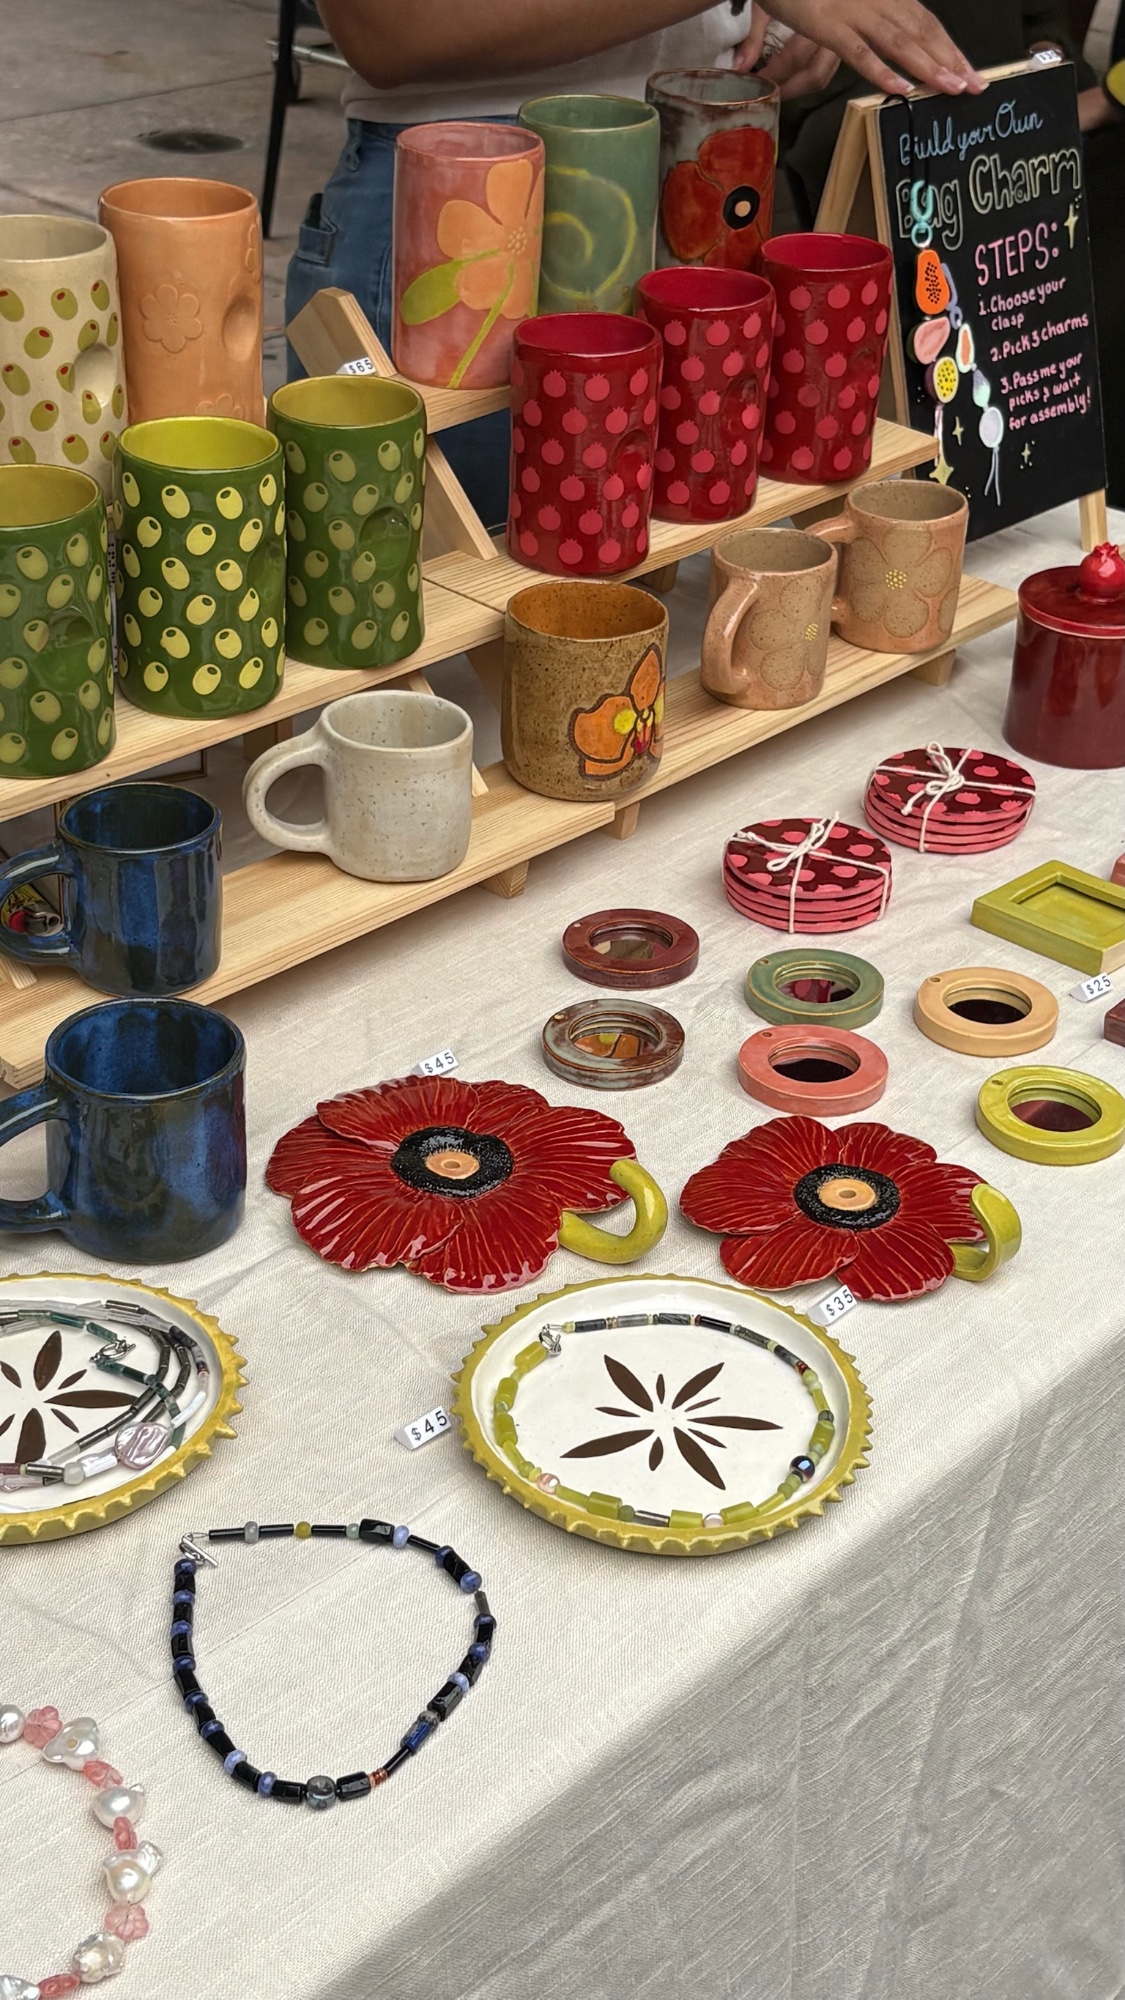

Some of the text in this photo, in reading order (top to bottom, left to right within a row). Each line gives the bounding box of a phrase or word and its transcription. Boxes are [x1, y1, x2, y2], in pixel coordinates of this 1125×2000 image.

[957, 125, 995, 161] your
[995, 100, 1043, 138] Own
[969, 148, 1081, 214] Charm
[974, 222, 1060, 286] STEPS:
[1036, 277, 1067, 305] your
[991, 312, 1025, 331] clasp
[1031, 329, 1041, 348] 3
[1041, 313, 1089, 341] charms
[348, 359, 374, 374] $65
[1040, 363, 1057, 379] me
[1058, 352, 1083, 380] your
[1009, 389, 1040, 412] picks
[1052, 371, 1081, 396] wait
[1009, 385, 1091, 431] for assembly!
[1086, 975, 1111, 995] $25
[424, 1051, 455, 1074] $45
[826, 1288, 854, 1317] $35
[411, 1410, 448, 1442] $45
